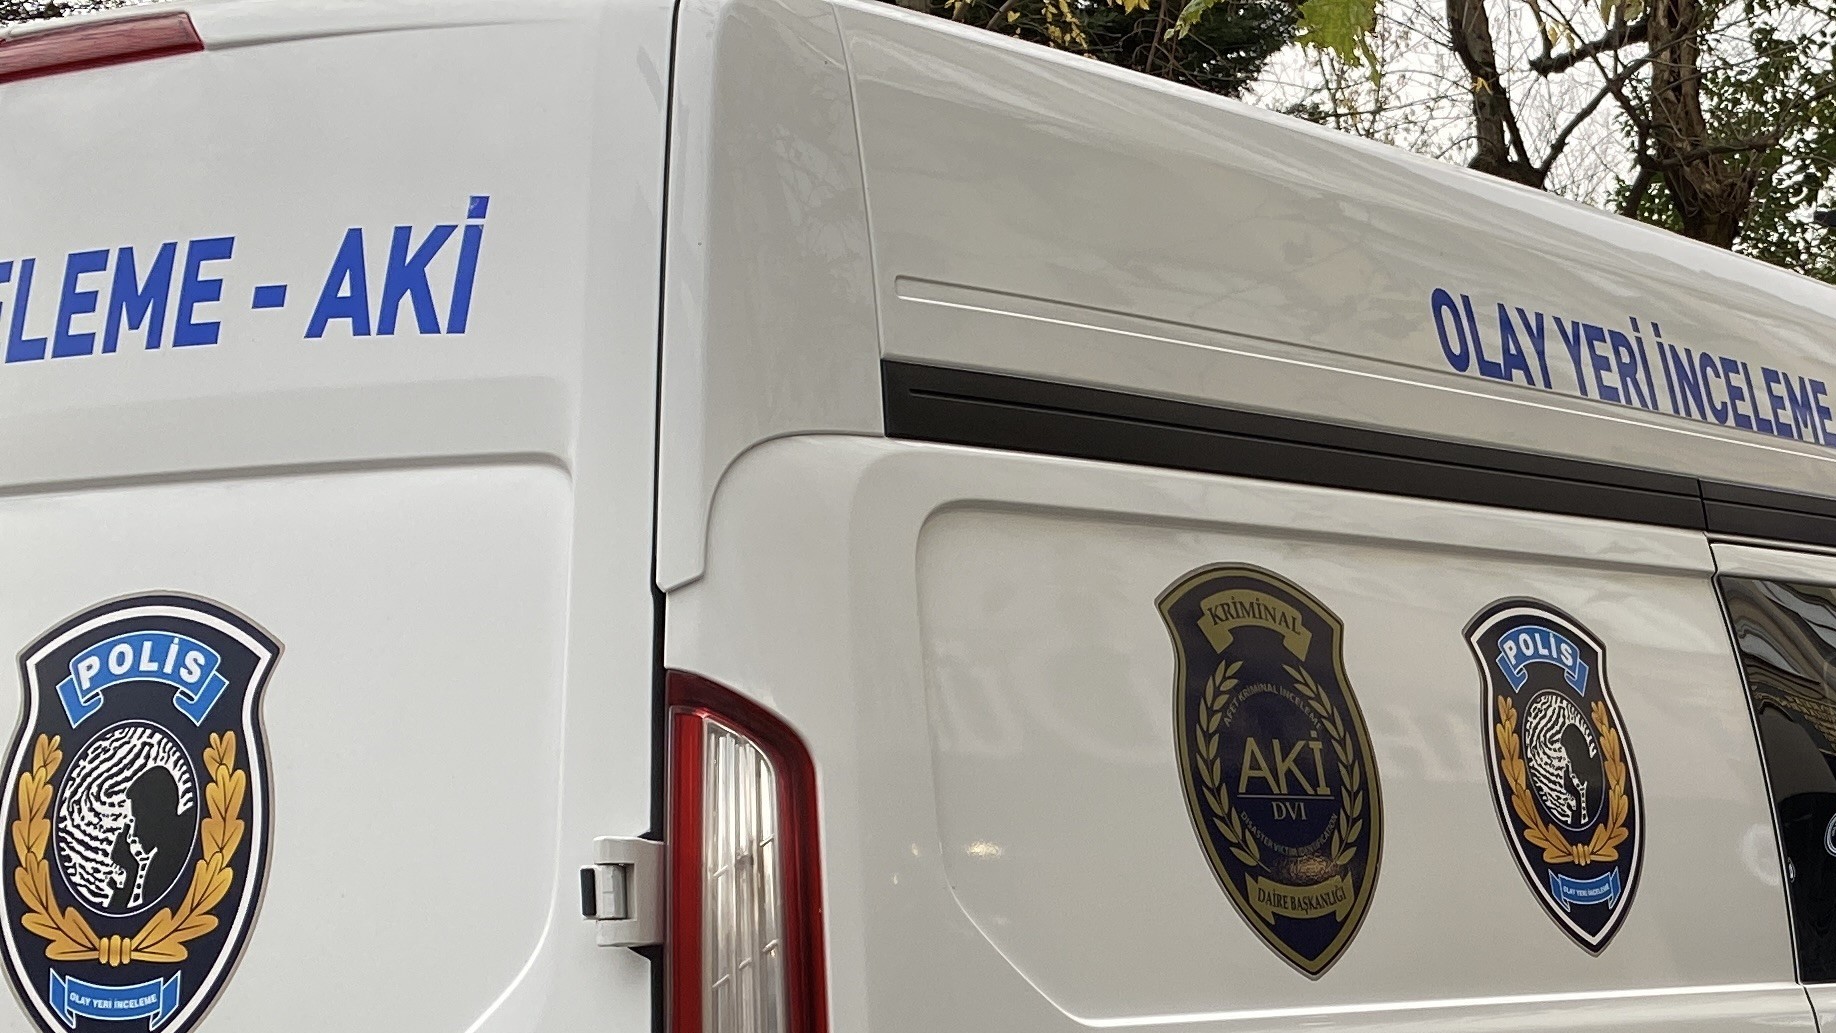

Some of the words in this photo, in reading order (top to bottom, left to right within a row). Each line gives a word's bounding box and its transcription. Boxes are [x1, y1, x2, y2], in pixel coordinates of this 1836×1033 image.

[303, 195, 490, 338] AKİ
[1431, 288, 1552, 389] OLAY
[1552, 316, 1658, 411] YERİ
[1207, 596, 1301, 635] KRİMİNAL
[78, 637, 205, 690] POLİS
[1503, 629, 1575, 668] POLİS
[1239, 730, 1331, 795] AKİ
[1271, 801, 1307, 821] DVI
[1258, 887, 1289, 910] DAİRE
[1289, 885, 1347, 915] BAŞKANLIĞI
[69, 992, 91, 1006] OLAY
